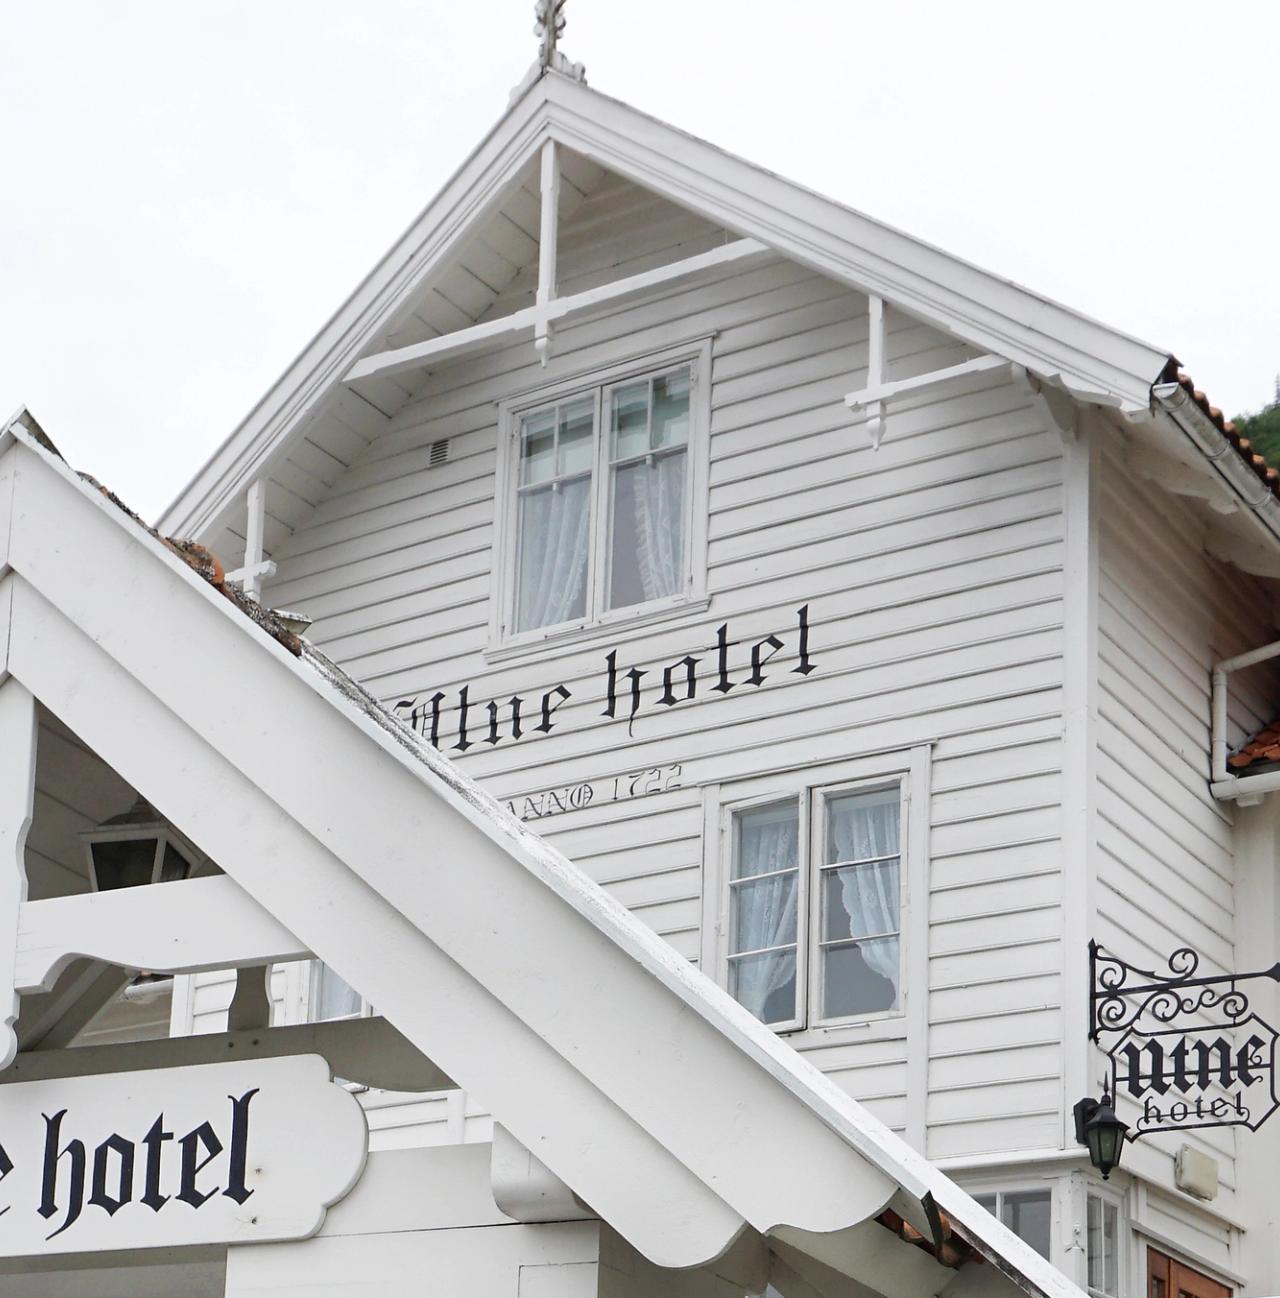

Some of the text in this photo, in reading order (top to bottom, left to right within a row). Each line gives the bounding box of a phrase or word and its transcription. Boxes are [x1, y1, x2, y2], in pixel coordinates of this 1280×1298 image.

[392, 603, 819, 753] Utne hotel
[612, 762, 683, 801] 1722
[1143, 1090, 1246, 1125] hotel
[36, 1087, 261, 1241] hotel
